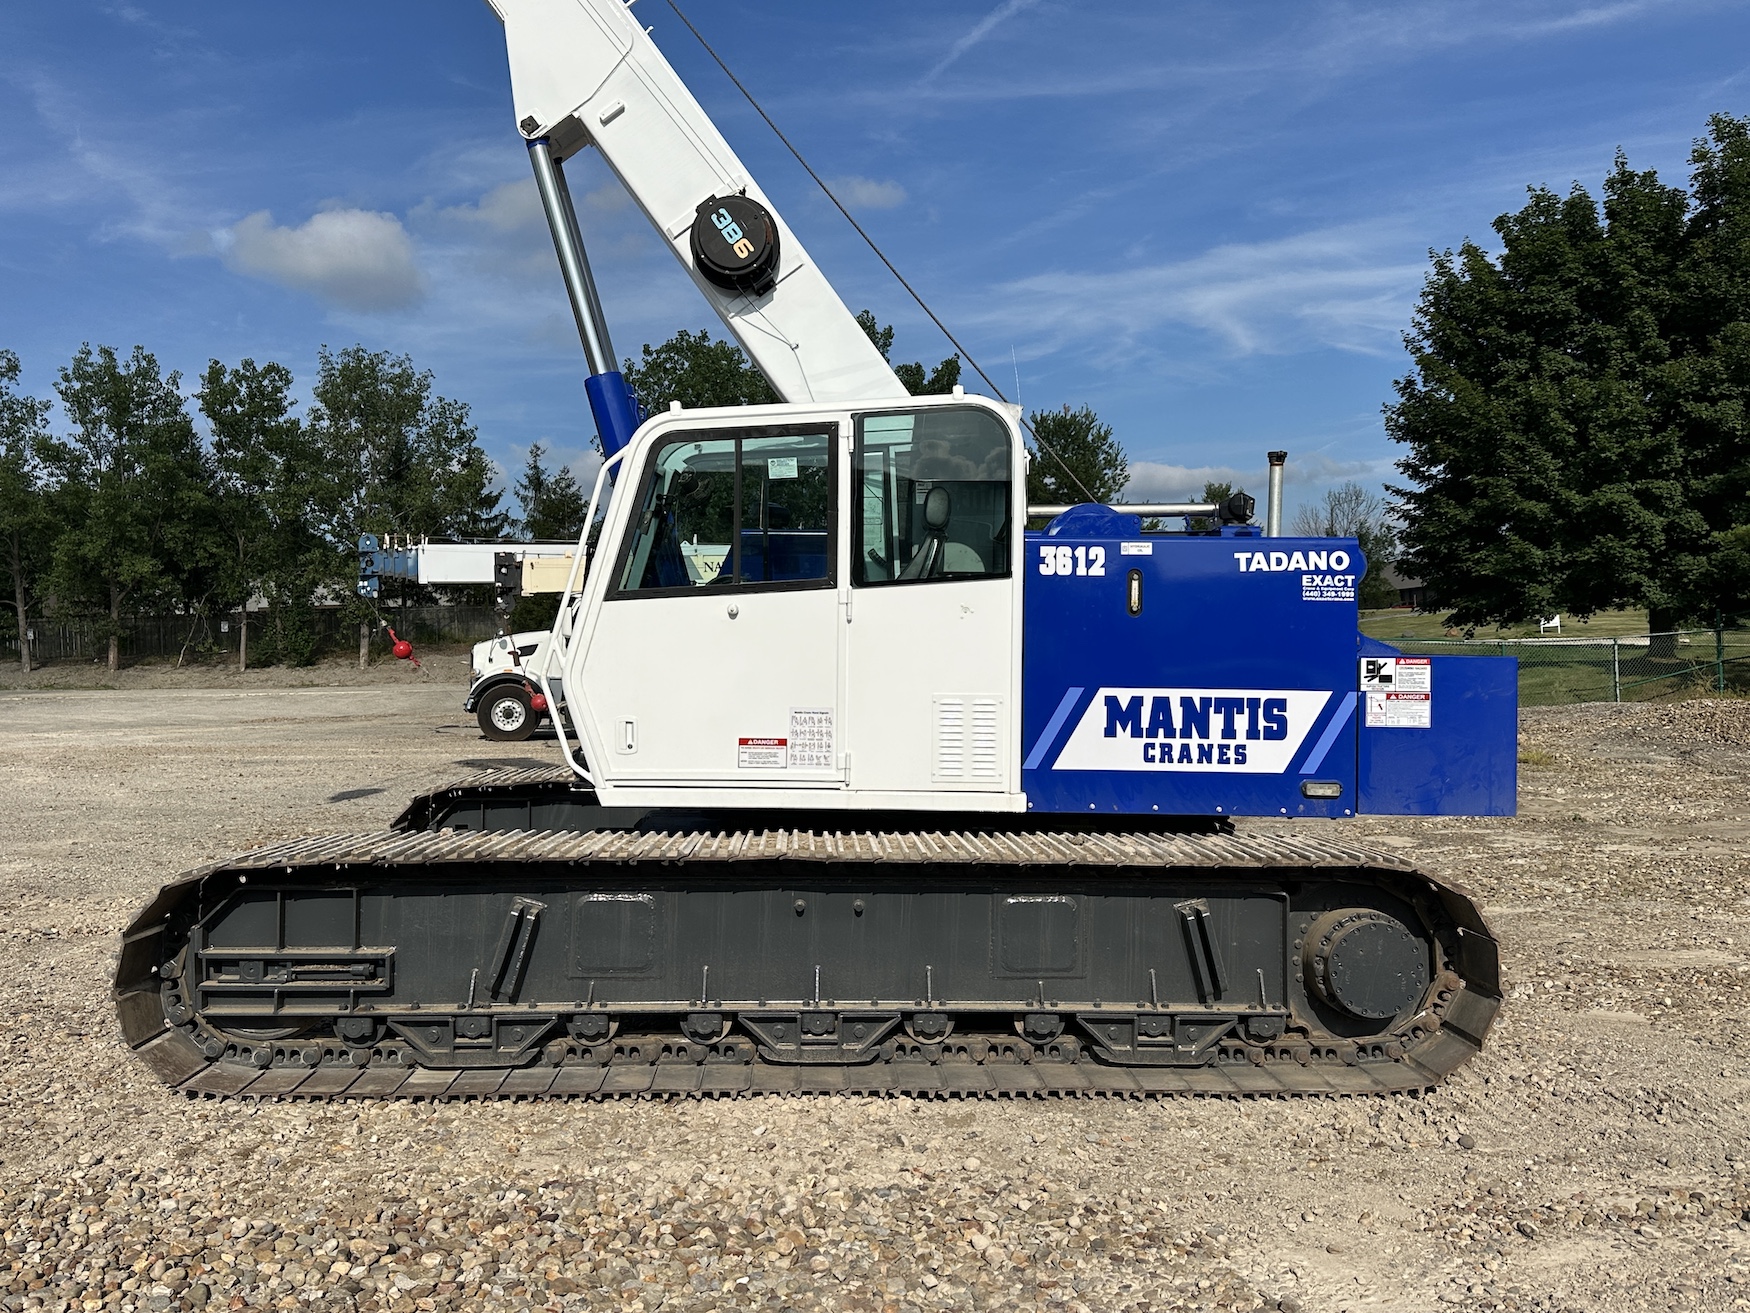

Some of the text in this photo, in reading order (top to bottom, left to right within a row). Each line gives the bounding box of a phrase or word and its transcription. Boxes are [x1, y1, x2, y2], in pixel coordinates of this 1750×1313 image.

[1038, 545, 1106, 576] 3612
[1233, 550, 1350, 572] TADANO
[1302, 574, 1355, 587] EXACT
[1302, 590, 1355, 598] (440) 349-1999
[1103, 695, 1288, 741] MANTIS
[1143, 742, 1247, 765] CRANES
